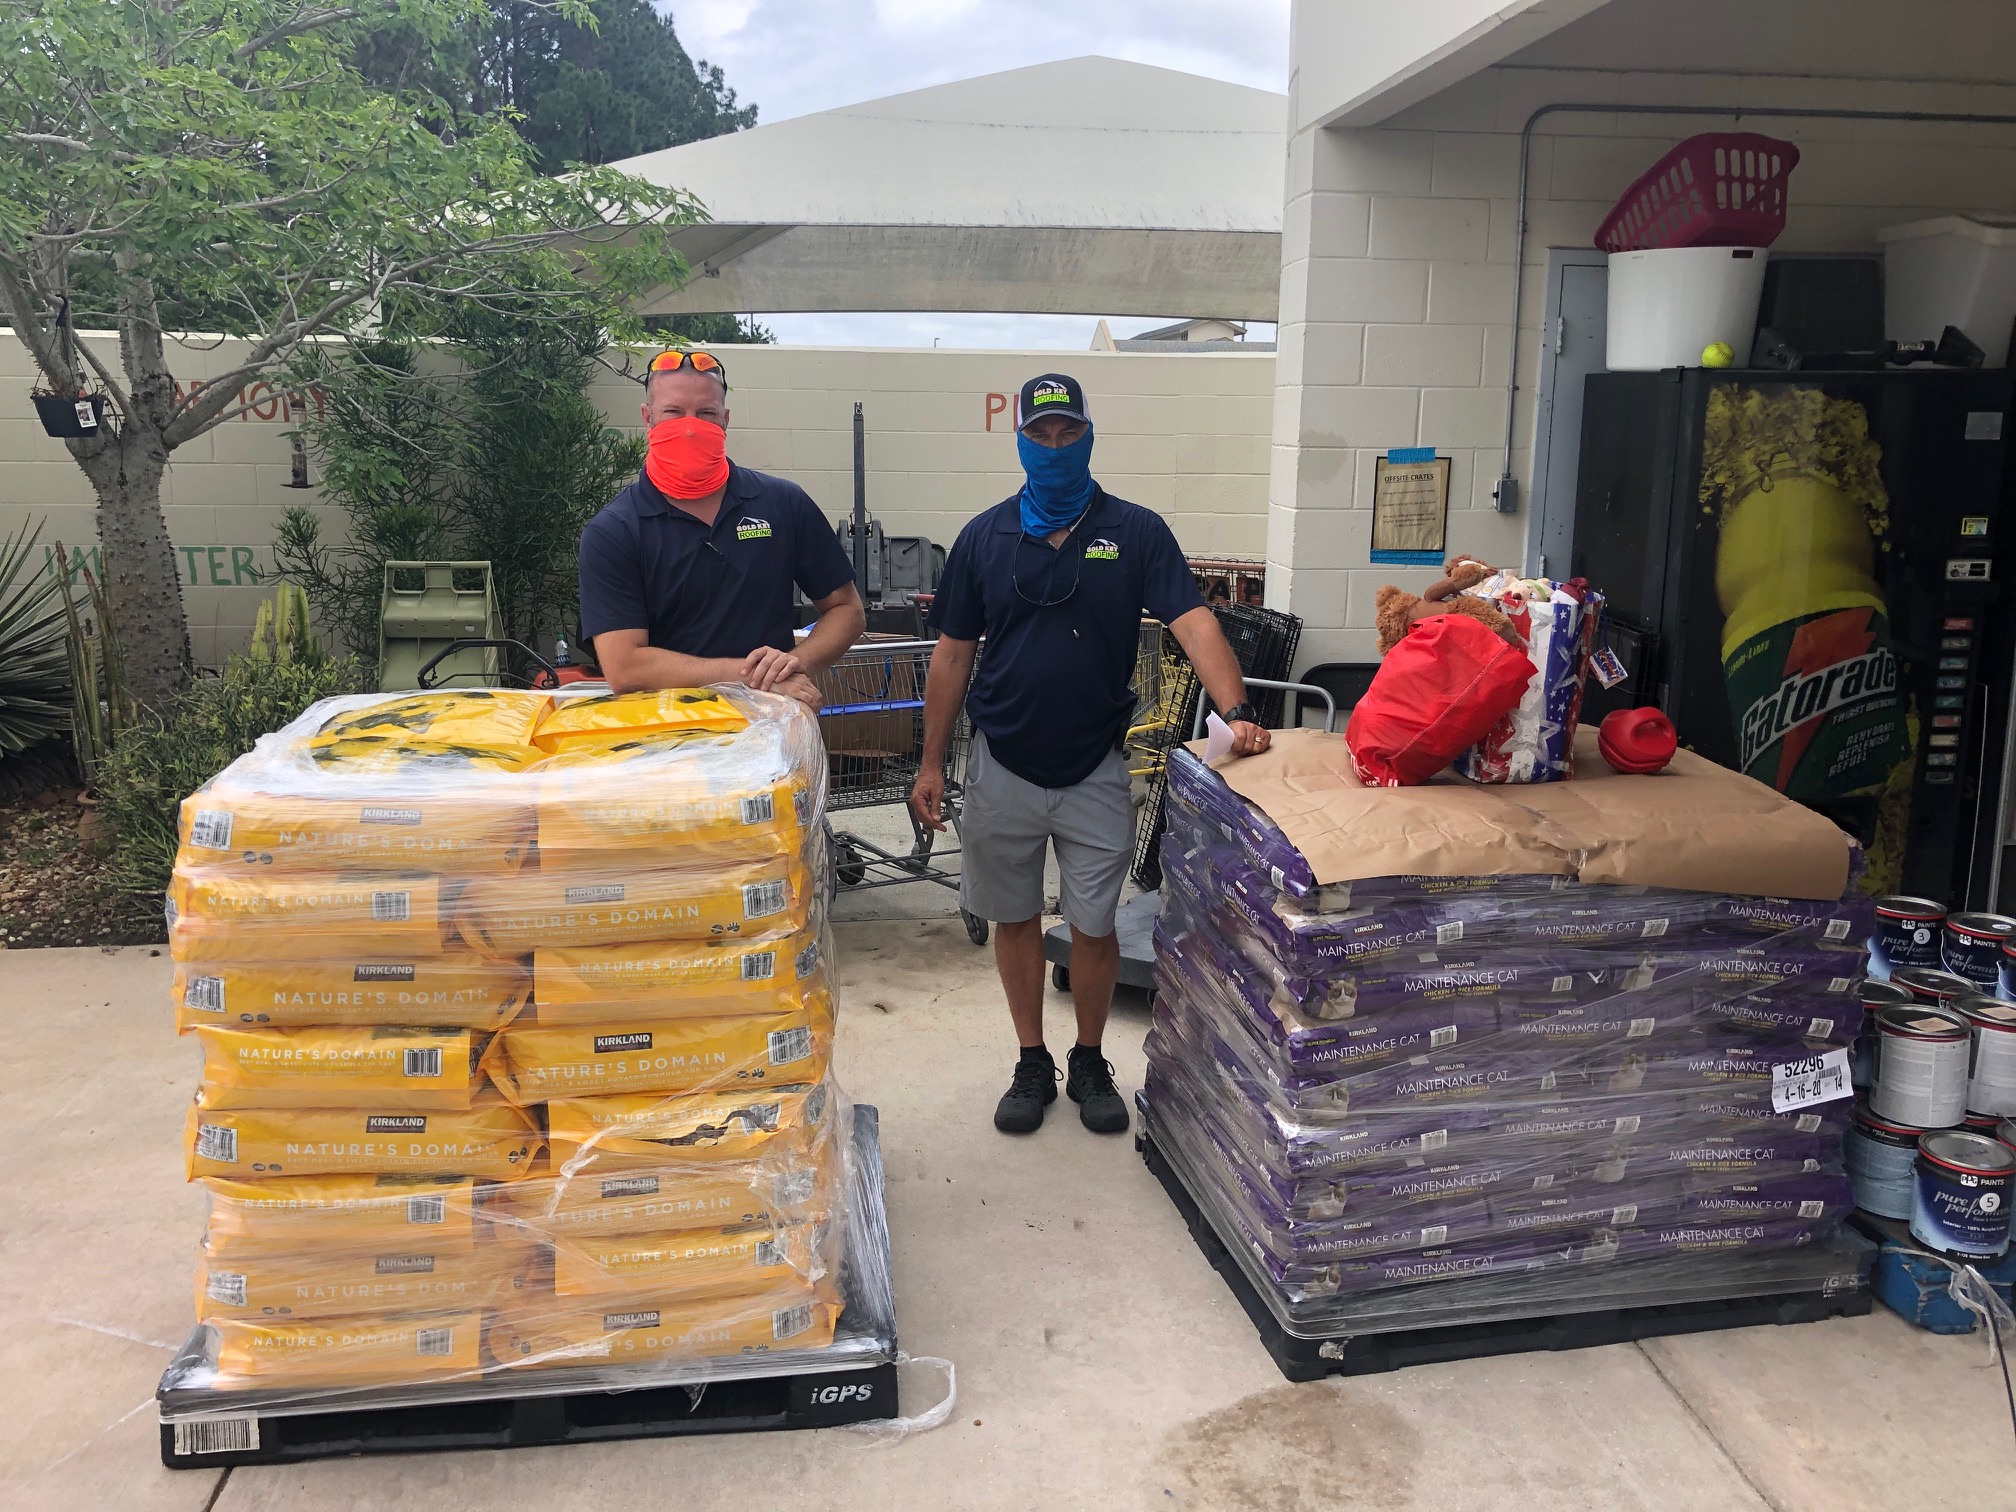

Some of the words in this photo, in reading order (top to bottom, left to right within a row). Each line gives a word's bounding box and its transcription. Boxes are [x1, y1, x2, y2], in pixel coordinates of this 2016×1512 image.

[1033, 388, 1052, 397] GOLD
[1035, 395, 1068, 404] ROOFING
[1410, 473, 1434, 481] CRATES
[736, 524, 757, 532] GOLD
[739, 529, 772, 539] ROOFING
[1086, 551, 1119, 559] ROOFING
[1740, 646, 1897, 775] Gatorade
[364, 808, 421, 819] KIRKLAND
[279, 830, 390, 848] NATURE'S
[566, 886, 624, 898] KIRKLAND
[295, 893, 364, 907] DOMAIN
[609, 905, 700, 926] DOMAIN
[1572, 908, 1599, 916] KIRKLAND
[1728, 905, 1802, 924] MAINTENANCE
[1802, 916, 1822, 928] CAT
[1354, 922, 1384, 934] KIRKLAND
[1534, 922, 1614, 936] MAINTENANCE
[1616, 921, 1636, 933] CAT
[1317, 934, 1402, 958] MAINTENANCE
[1406, 929, 1427, 943] CAT
[1882, 936, 1908, 946] pure
[1973, 940, 1996, 948] PAINTS
[358, 965, 413, 975] KIRKLAND
[669, 956, 734, 970] DOMAIN
[1444, 962, 1475, 970] KIRKLAND
[1700, 959, 1780, 974] MAINTENANCE
[1782, 963, 1804, 975] CAT
[1950, 954, 1999, 974] performa
[1404, 972, 1495, 994] MAINTENANCE
[1498, 969, 1519, 982] CAT
[274, 991, 386, 1006] NATURE'S
[398, 986, 489, 1005] DOMAIN
[1712, 1002, 1784, 1023] MAINTENANCE
[1785, 1014, 1804, 1026] CAT
[1348, 1027, 1378, 1038] KIRKLAND
[1520, 1022, 1600, 1035] MAINTENANCE
[1602, 1020, 1622, 1032] CAT
[597, 1034, 650, 1046] KIRKLAND
[239, 1047, 320, 1060] NATURE'S
[328, 1047, 396, 1060] DOMAIN
[1312, 1038, 1397, 1063] MAINTENANCE
[1400, 1033, 1421, 1047] CAT
[638, 1051, 728, 1072] DOMAIN
[1434, 1063, 1466, 1072] KIRKLAND
[1688, 1060, 1768, 1073] MAINTENANCE
[1784, 1055, 1824, 1078] 52296
[1396, 1072, 1484, 1096] MAINTENANCE
[1488, 1070, 1509, 1082] CAT
[1784, 1080, 1822, 1102] 4-16-20
[1834, 1074, 1842, 1091] 14
[592, 1110, 670, 1124] NATURE'S
[1699, 1104, 1772, 1121] MAINTENANCE
[370, 1117, 425, 1128] KIRKLAND
[1504, 1121, 1585, 1134] MAINTENANCE
[1587, 1119, 1608, 1130] CAT
[1340, 1132, 1369, 1142] KIRKLAND
[286, 1143, 398, 1157] NATURE'S
[1305, 1142, 1387, 1168] MAINTENANCE
[1390, 1137, 1412, 1151] CAT
[1670, 1148, 1751, 1161] MAINTENANCE
[1754, 1148, 1775, 1160] CAT
[1430, 1164, 1460, 1174] KIRKLAND
[604, 1178, 658, 1192] KIRKLAND
[1392, 1174, 1478, 1197] MAINTENANCE
[1480, 1171, 1502, 1184] CAT
[1980, 1178, 2004, 1186] PAINTS
[1698, 1200, 1772, 1210] MAINTENANCE
[1774, 1200, 1794, 1210] CAT
[1934, 1190, 1968, 1206] pure
[646, 1196, 733, 1216] DOMAIN
[1343, 1221, 1372, 1231] KIRKLAND
[1507, 1212, 1583, 1228] MAINTENANCE
[1586, 1210, 1604, 1221] CAT
[1942, 1219, 1962, 1228] Interior
[1660, 1227, 1742, 1243] MAINTENANCE
[1744, 1226, 1765, 1239] CAT
[1307, 1233, 1390, 1254] MAINTENANCE
[1392, 1231, 1413, 1241] CAT
[600, 1249, 678, 1265] NATURE'S
[685, 1244, 749, 1260] DOMAIN
[378, 1256, 433, 1268] KIRKLAND
[1384, 1258, 1470, 1279] MAINTENANCE
[1472, 1256, 1495, 1269] CAT
[296, 1282, 407, 1299] NATURE'S
[606, 1312, 658, 1324] KIRKLAND
[254, 1336, 334, 1348] NATURE'S
[810, 1383, 874, 1405] iGPS
